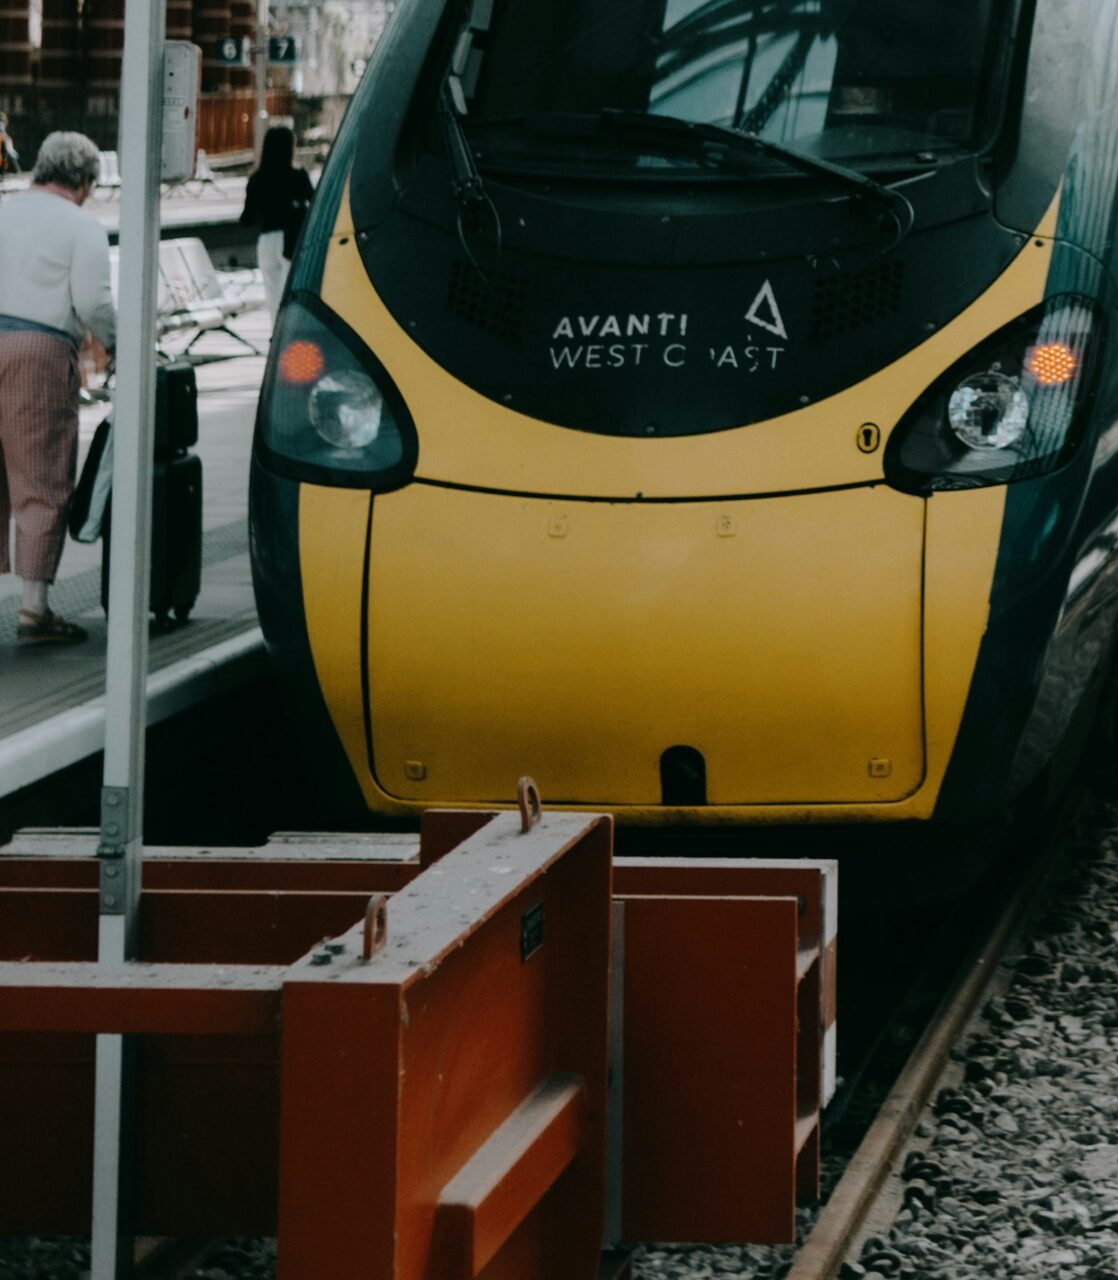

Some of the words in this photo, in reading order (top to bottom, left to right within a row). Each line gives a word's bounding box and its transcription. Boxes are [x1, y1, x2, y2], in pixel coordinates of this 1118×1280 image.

[222, 39, 238, 60] 6
[277, 41, 290, 59] 7
[552, 313, 688, 339] AVANTI
[549, 343, 649, 369] WEST
[662, 343, 785, 372] CAST
